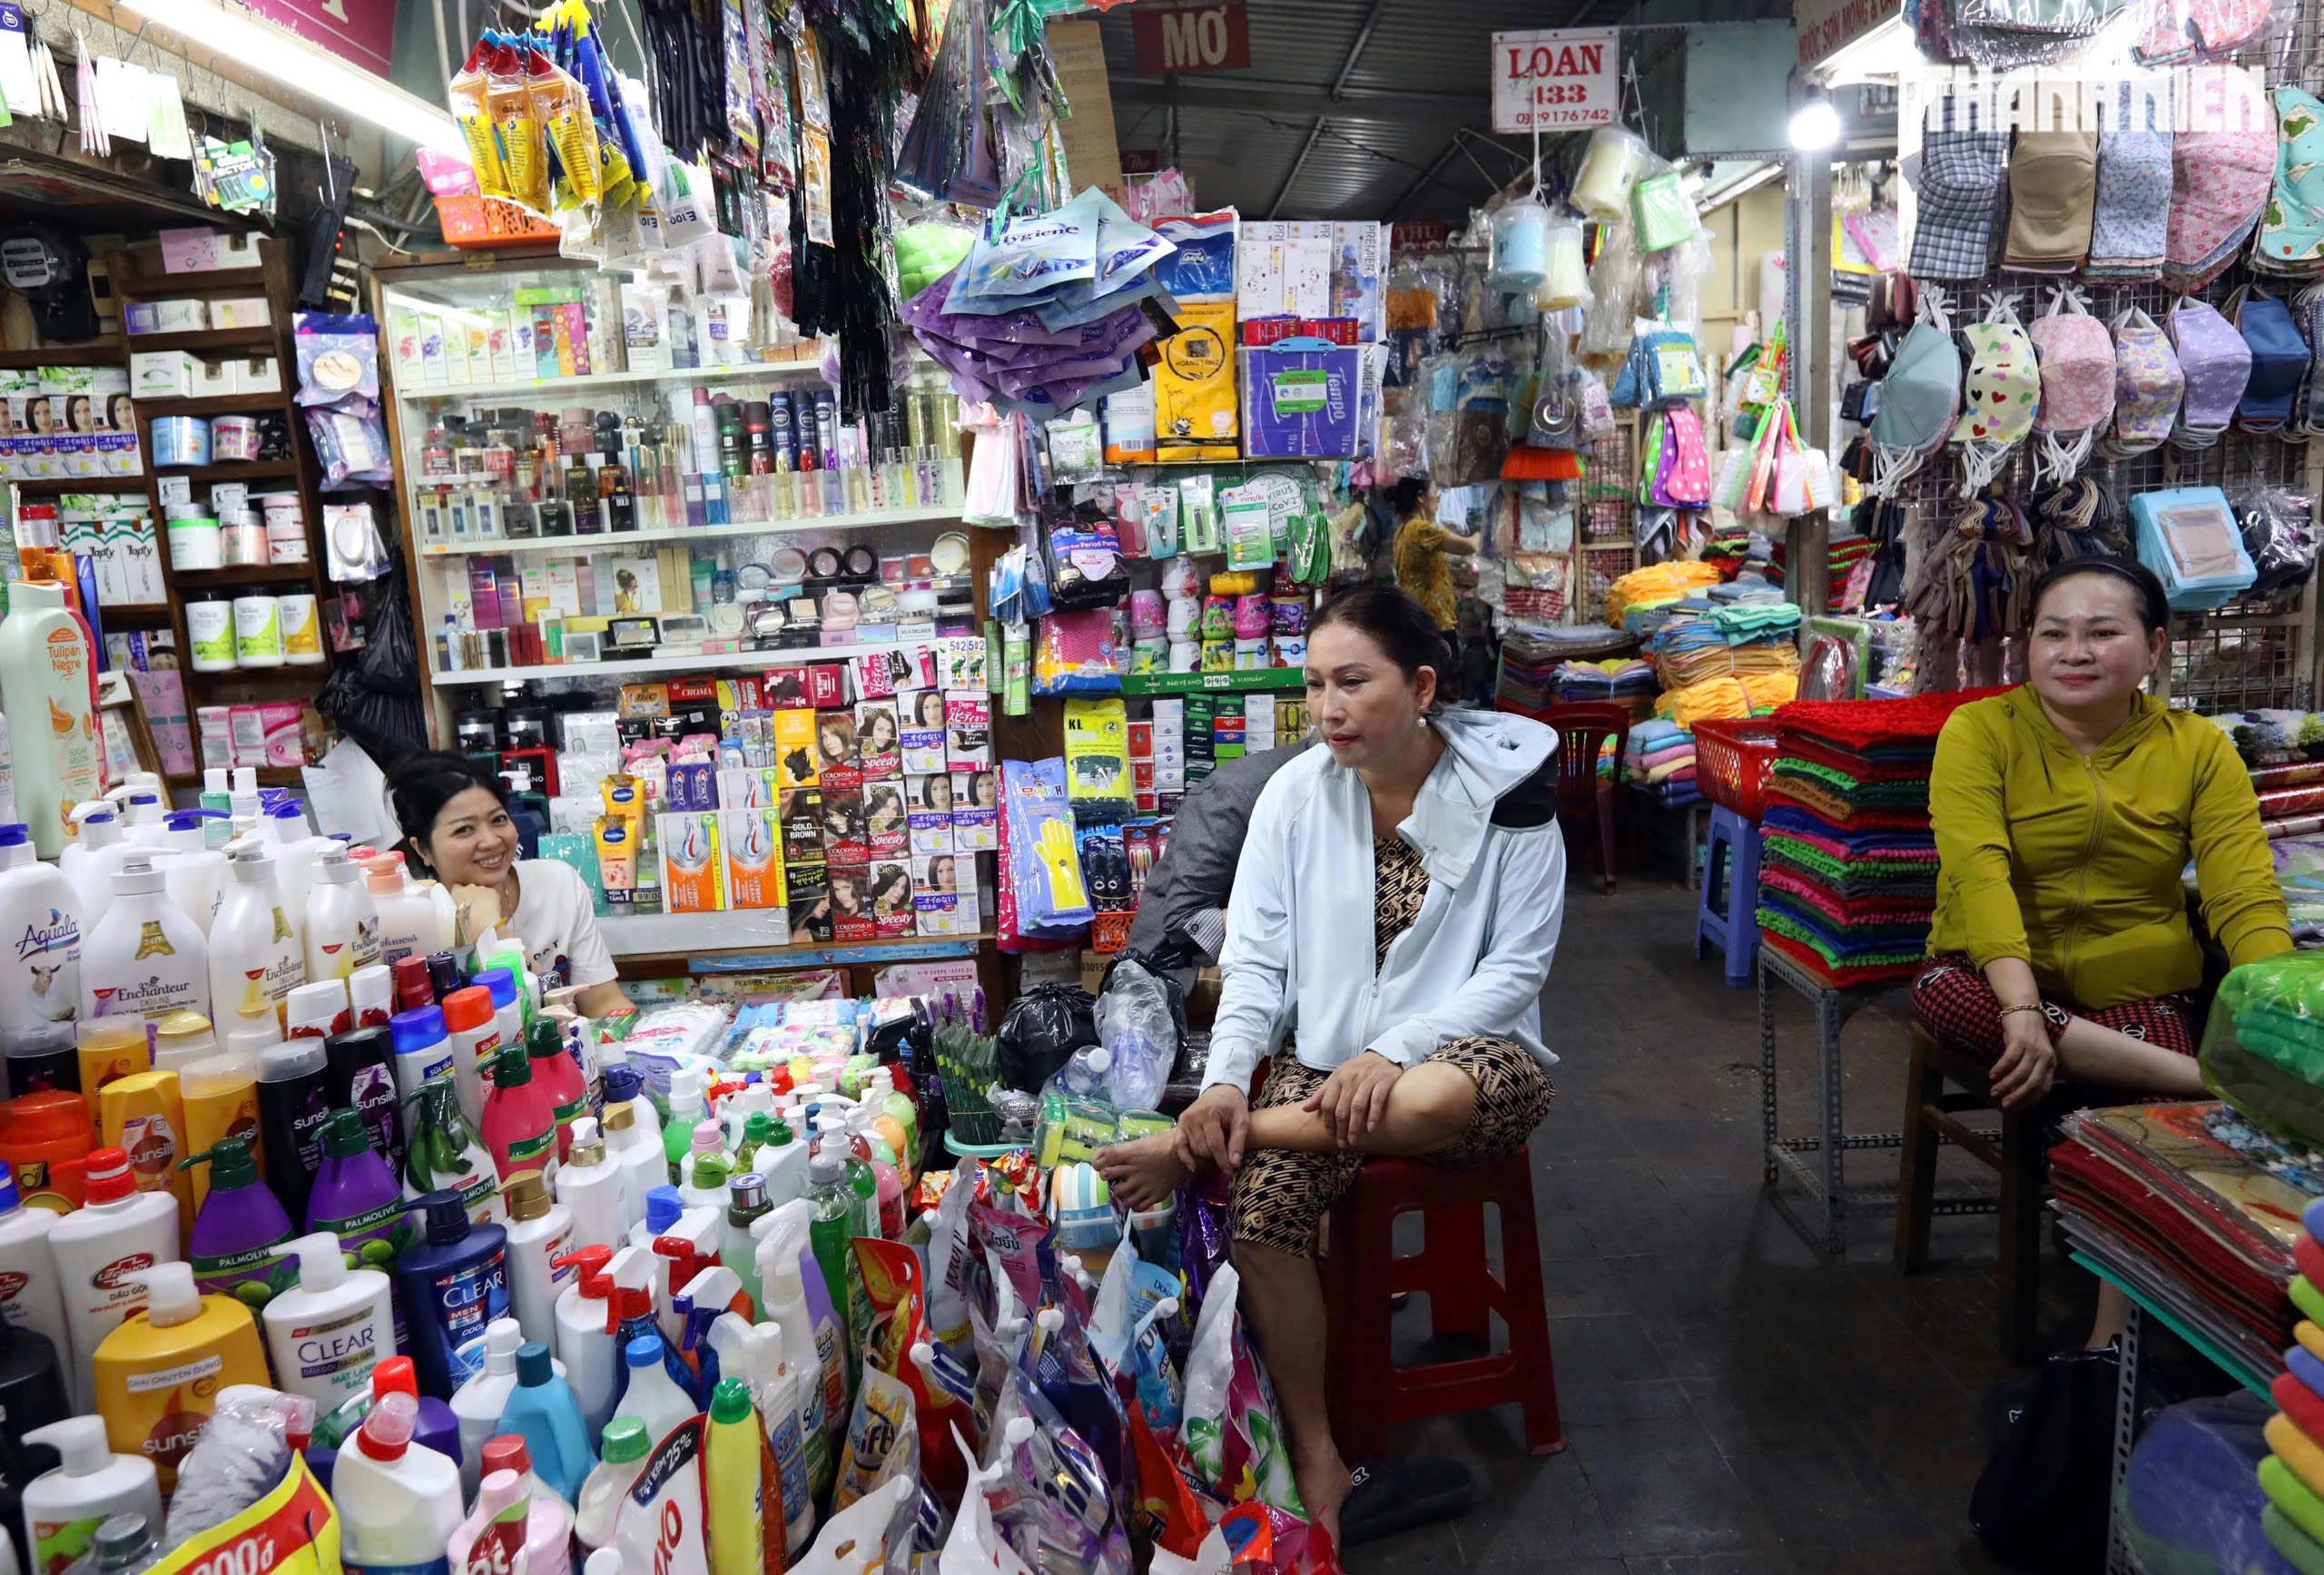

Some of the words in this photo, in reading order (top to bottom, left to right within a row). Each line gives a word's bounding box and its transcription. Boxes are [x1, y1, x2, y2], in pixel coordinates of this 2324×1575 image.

[1508, 44, 1604, 79] LOAN
[1364, 224, 1376, 273] PREMIER
[1326, 373, 1346, 420] Tempo
[47, 645, 81, 658] Tulipán
[950, 640, 967, 652] 502
[968, 639, 986, 651] 502
[52, 660, 82, 674] Negro
[681, 687, 713, 697] CROMA
[1068, 718, 1083, 731] KL
[1108, 722, 1115, 730] 2
[863, 756, 900, 769] Speedy
[821, 771, 859, 779] COLORSILK
[792, 822, 812, 832] GOLD
[789, 830, 817, 840] BROWN
[870, 833, 906, 846] Speedy
[827, 846, 865, 854] COLORSILK
[877, 912, 913, 925] Speedy
[834, 922, 872, 930] COLORSILK
[15, 914, 80, 955] Aquala
[379, 934, 418, 948] ohnson's
[266, 960, 303, 981] Enchanteur
[118, 981, 190, 1002] Enchanteur
[355, 1089, 397, 1111] sunsilk
[344, 1203, 397, 1229] PALMOLIVE
[218, 1246, 272, 1268] PALMOLIV
[442, 1270, 503, 1308] CLEAR
[450, 1304, 478, 1319] MEN
[461, 1322, 486, 1336] COOL
[298, 1327, 375, 1363] CLEAR
[665, 1432, 693, 1472] 25%
